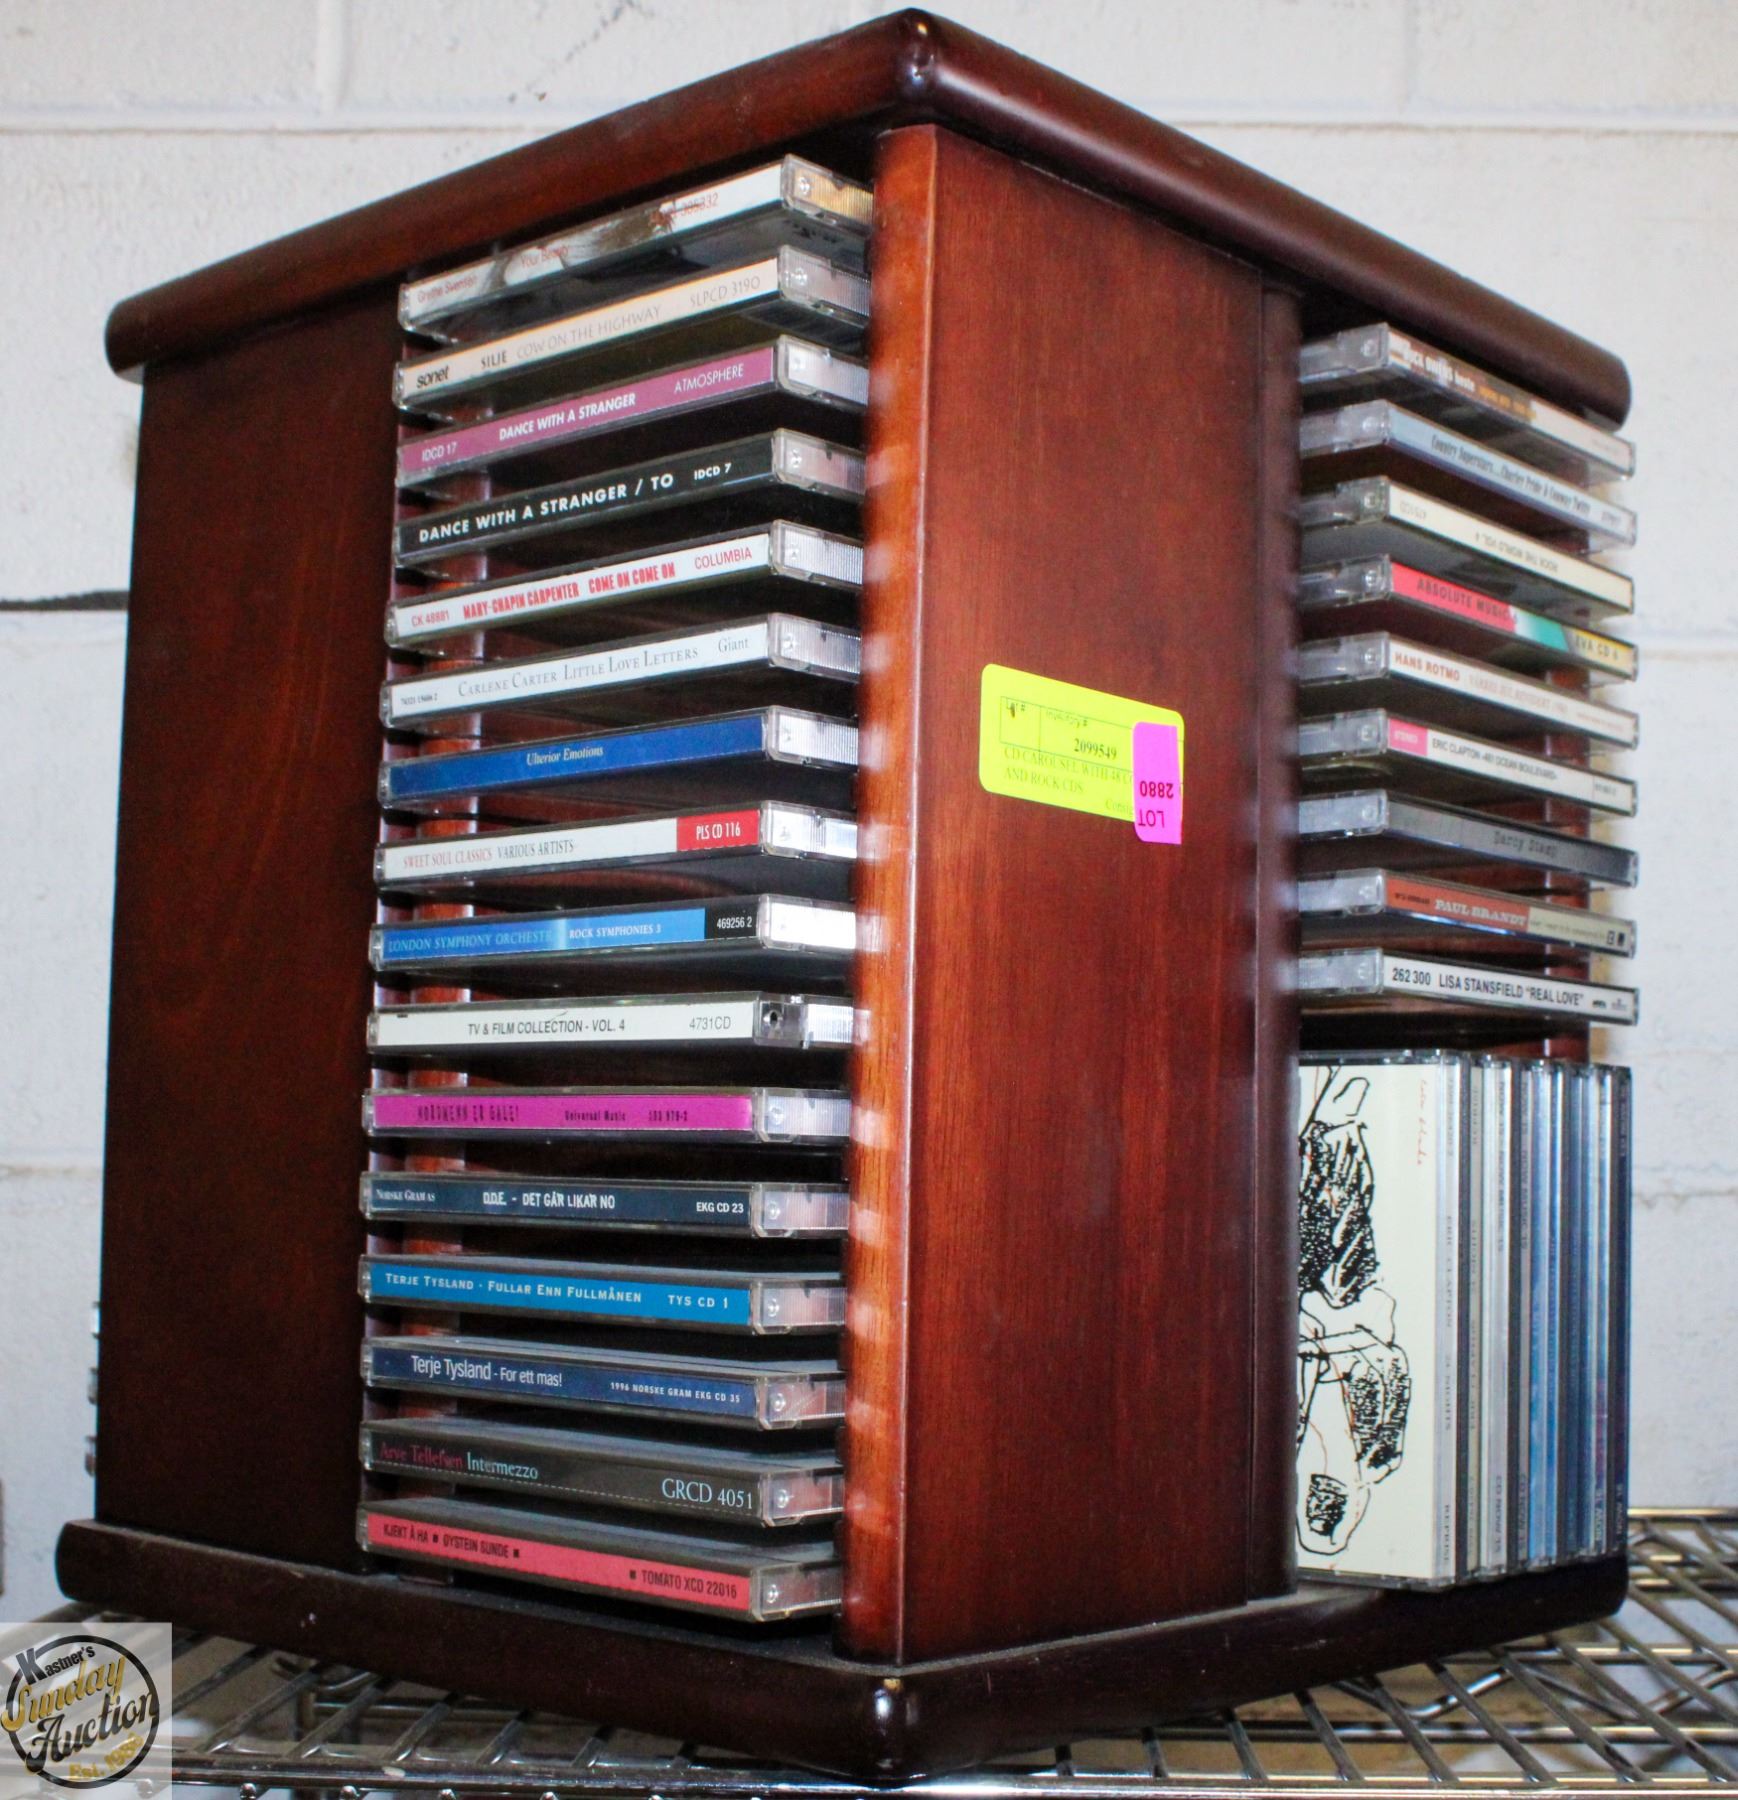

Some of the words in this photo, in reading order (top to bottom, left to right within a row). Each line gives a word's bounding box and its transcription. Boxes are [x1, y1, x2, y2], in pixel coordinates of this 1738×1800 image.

[416, 364, 450, 390] sonet
[516, 336, 546, 361] COW
[548, 331, 569, 351] ON
[569, 322, 595, 346] THE
[598, 304, 662, 338] HIGHWAY
[689, 281, 728, 308] SLPCD
[731, 274, 761, 297] 3190
[498, 421, 535, 442] DANCE
[536, 413, 565, 435] WITH
[566, 409, 576, 423] A
[578, 392, 636, 420] STRANGER
[673, 363, 744, 394] ATMOSPHERE
[445, 441, 457, 456] 17
[419, 520, 471, 543] DANCE
[476, 508, 516, 530] WITH
[522, 505, 534, 520] A
[540, 484, 628, 516] STRANGER
[634, 478, 644, 496] /
[650, 473, 674, 493] TO
[694, 466, 721, 481] IDCD
[724, 462, 732, 476] 7
[411, 612, 424, 627] CK
[463, 590, 526, 620] MARY-CHAPIN
[527, 581, 580, 606] CARPENTER
[588, 573, 618, 595] COME
[618, 571, 630, 588] ON
[632, 566, 660, 587] COME
[662, 562, 675, 579] ON
[694, 546, 753, 570] COLUMBIA
[1416, 578, 1473, 609] ABSOLUTE
[1476, 600, 1513, 624] MUSIC
[1597, 641, 1608, 658] CD
[458, 672, 509, 698] CARLENE
[511, 666, 558, 689] CARTER
[563, 660, 604, 681] LITTLE
[609, 654, 639, 674] LOVE
[644, 646, 699, 669] LETTERS
[718, 636, 750, 655] Giant
[1394, 651, 1423, 674] HANS
[1425, 659, 1460, 682] ROTMO
[527, 749, 561, 766] Ulterior
[563, 745, 604, 762] Emotions
[1004, 746, 1020, 760] CD
[1022, 751, 1079, 773] CAROUSEL
[1082, 762, 1108, 780] WITH
[1074, 738, 1117, 760] 2099549
[1432, 738, 1449, 751] ERIC
[1450, 742, 1481, 761] CLAPTON
[1004, 767, 1028, 781] AND
[1031, 772, 1060, 790] ROCK
[1063, 778, 1084, 793] CDS
[1139, 780, 1174, 798] 2880
[1138, 810, 1165, 828] LOT
[402, 851, 430, 869] SWEET
[431, 849, 453, 867] SOUL
[455, 847, 493, 865] CLASSICS
[497, 841, 536, 860] VARIOUS
[537, 839, 574, 857] ARTISTS
[696, 824, 710, 841] PLS
[712, 823, 723, 839] CD
[725, 822, 741, 837] 116
[1435, 899, 1470, 917] PAUL
[1471, 905, 1528, 927] BRANDT
[388, 933, 432, 953] LONDON
[434, 930, 492, 950] SYMPHONY
[569, 926, 594, 939] ROCK
[596, 924, 653, 938] SYMPHONIES
[716, 915, 743, 930] 469256
[746, 915, 753, 928] 2
[1392, 967, 1411, 983] 262
[1413, 970, 1431, 986] 300
[1439, 973, 1462, 991] LISA
[1463, 978, 1524, 999] STANSFIELD
[468, 1022, 480, 1037] TV
[482, 1022, 489, 1036] &
[492, 1021, 515, 1037] FILM
[517, 1019, 583, 1034] COLLECTION
[592, 1019, 616, 1033] VOL.
[618, 1019, 625, 1033] 4
[689, 1015, 731, 1031] 4731CD
[564, 1109, 601, 1122] Universal
[604, 1110, 626, 1123] Music
[522, 1191, 541, 1208] DET
[600, 1194, 616, 1210] NO
[696, 1201, 715, 1212] EKG
[716, 1201, 730, 1213] CD
[732, 1201, 744, 1214] 23
[1446, 1215, 1454, 1249] ERIC
[386, 1273, 419, 1287] TERJE
[423, 1276, 474, 1290] TYSLAND
[488, 1280, 532, 1295] FULLAR
[536, 1282, 562, 1297] ENN
[566, 1285, 642, 1303] FULLMÅNEN
[668, 1295, 693, 1306] TYS
[696, 1295, 716, 1308] CD
[723, 1297, 729, 1310] 1
[1445, 1257, 1454, 1329] CLAPTON
[411, 1355, 442, 1378] Terje
[442, 1357, 491, 1381] Tysland
[500, 1367, 516, 1382] For
[518, 1369, 534, 1385] ett
[536, 1371, 563, 1388] mas!
[610, 1381, 629, 1392] 1996
[632, 1384, 665, 1395] NORSKE
[667, 1386, 692, 1398] GRAM
[695, 1389, 712, 1401] EKG
[714, 1391, 727, 1401] CD
[730, 1392, 741, 1403] 35
[1444, 1374, 1452, 1433] NIGHTS
[467, 1452, 539, 1480] Intermezzo
[661, 1478, 713, 1504] GRCD
[717, 1486, 753, 1510] 4051
[1443, 1503, 1451, 1564] REPRISE
[480, 1538, 509, 1558] SUNDE
[642, 1570, 681, 1589] TOMATO
[682, 1575, 704, 1593] XCD
[705, 1578, 737, 1599] 22016
